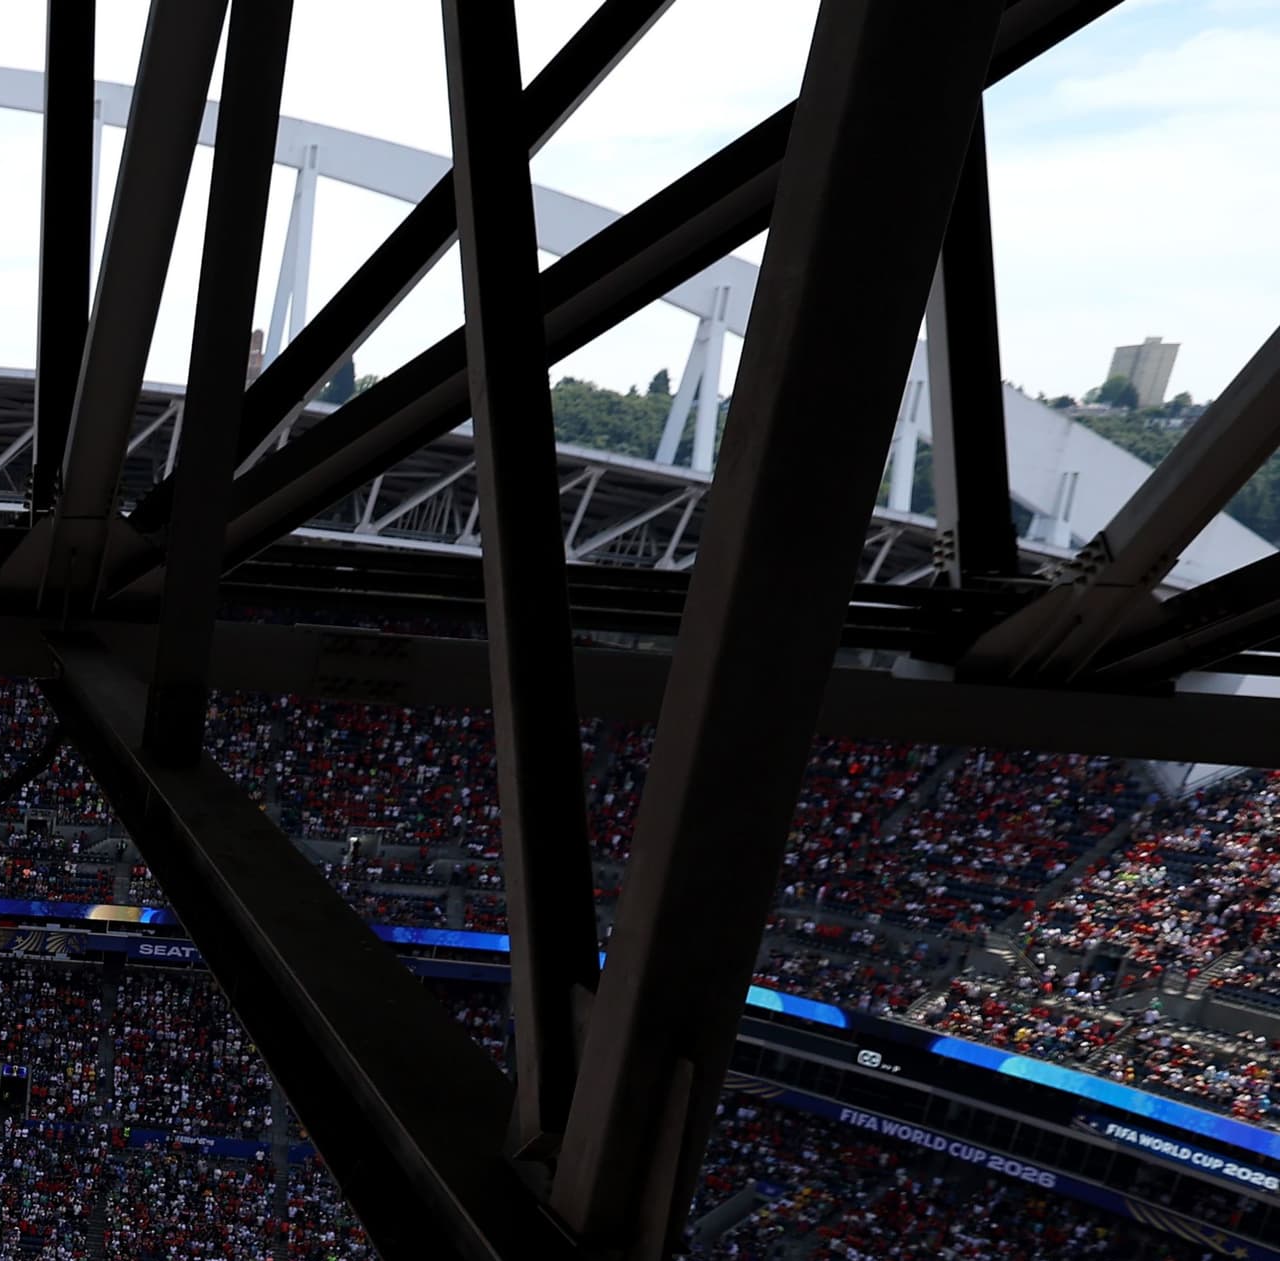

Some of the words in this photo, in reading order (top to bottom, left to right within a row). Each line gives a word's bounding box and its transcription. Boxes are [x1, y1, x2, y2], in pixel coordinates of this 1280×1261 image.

[138, 943, 198, 958] SEAT
[839, 1108, 879, 1132] FIFA
[879, 1119, 948, 1152] WORLD
[948, 1142, 988, 1164] CUP
[986, 1155, 1057, 1189] 2026
[1105, 1123, 1139, 1143] FIFA
[1138, 1134, 1192, 1160] WORLD
[1191, 1152, 1226, 1170] CUP
[1223, 1163, 1280, 1190] 2026
